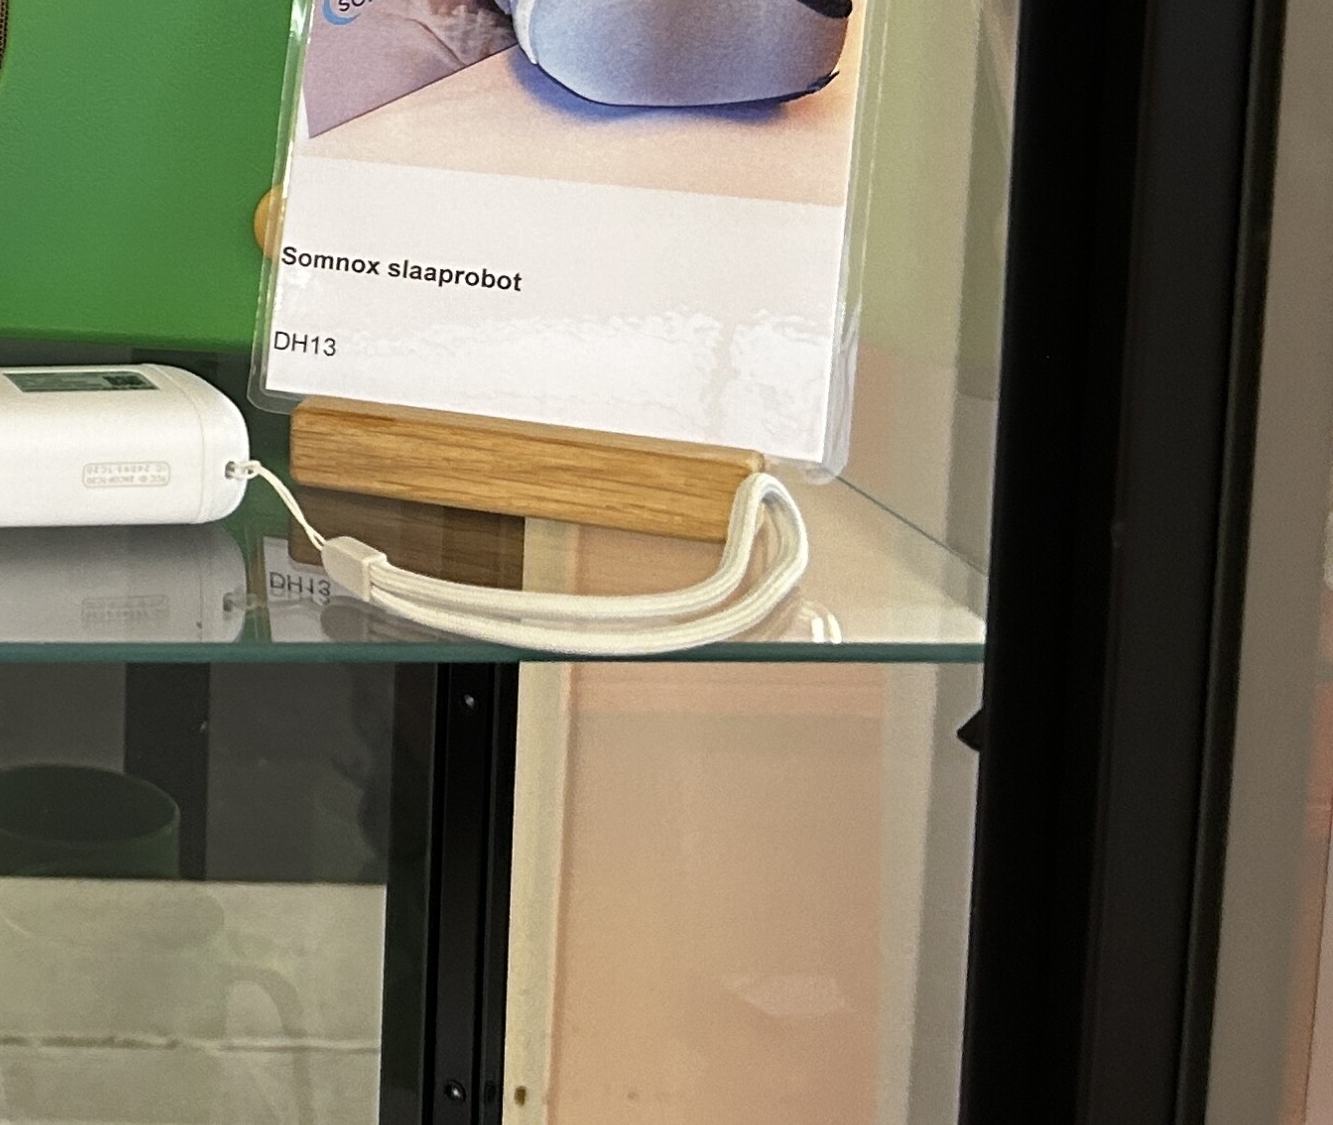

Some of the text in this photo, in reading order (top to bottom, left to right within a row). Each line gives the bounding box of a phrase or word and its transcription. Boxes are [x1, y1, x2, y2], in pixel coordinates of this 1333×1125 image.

[281, 246, 522, 293] Somnox slaaprobot
[274, 331, 337, 357] DH13
